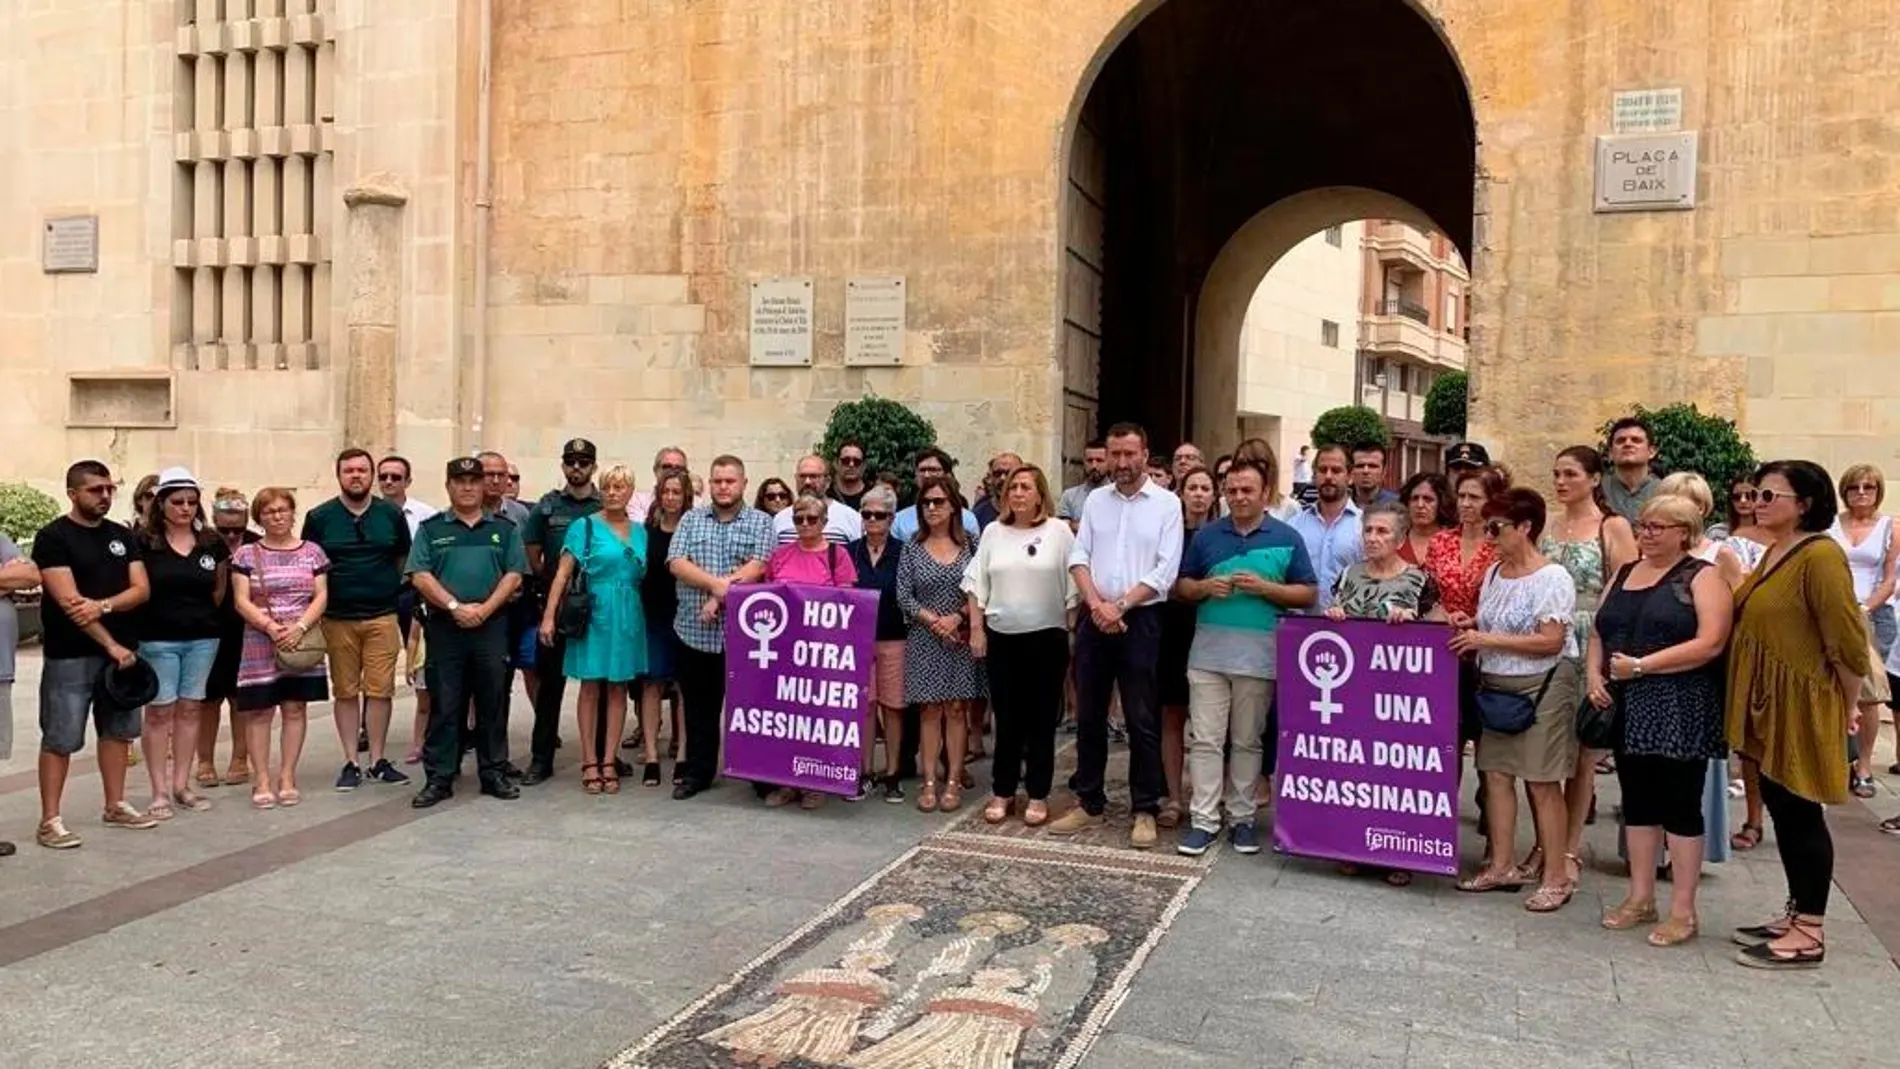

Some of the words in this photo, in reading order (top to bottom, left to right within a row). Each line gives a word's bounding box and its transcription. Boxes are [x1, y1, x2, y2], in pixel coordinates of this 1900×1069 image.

[1623, 178, 1666, 192] BAIX
[1636, 165, 1657, 176] DE
[803, 601, 854, 628] HOY
[793, 640, 855, 671] OTRA
[1370, 645, 1432, 673] AVUI
[776, 676, 858, 709] MUJER
[1375, 694, 1431, 724] UNA
[729, 708, 860, 748] ASESINADA
[1293, 734, 1364, 763] ALTRA
[1374, 741, 1442, 772] DONA
[792, 757, 856, 782] feminista
[1282, 775, 1452, 817] ASSASSINADA
[1365, 827, 1453, 857] feminista
